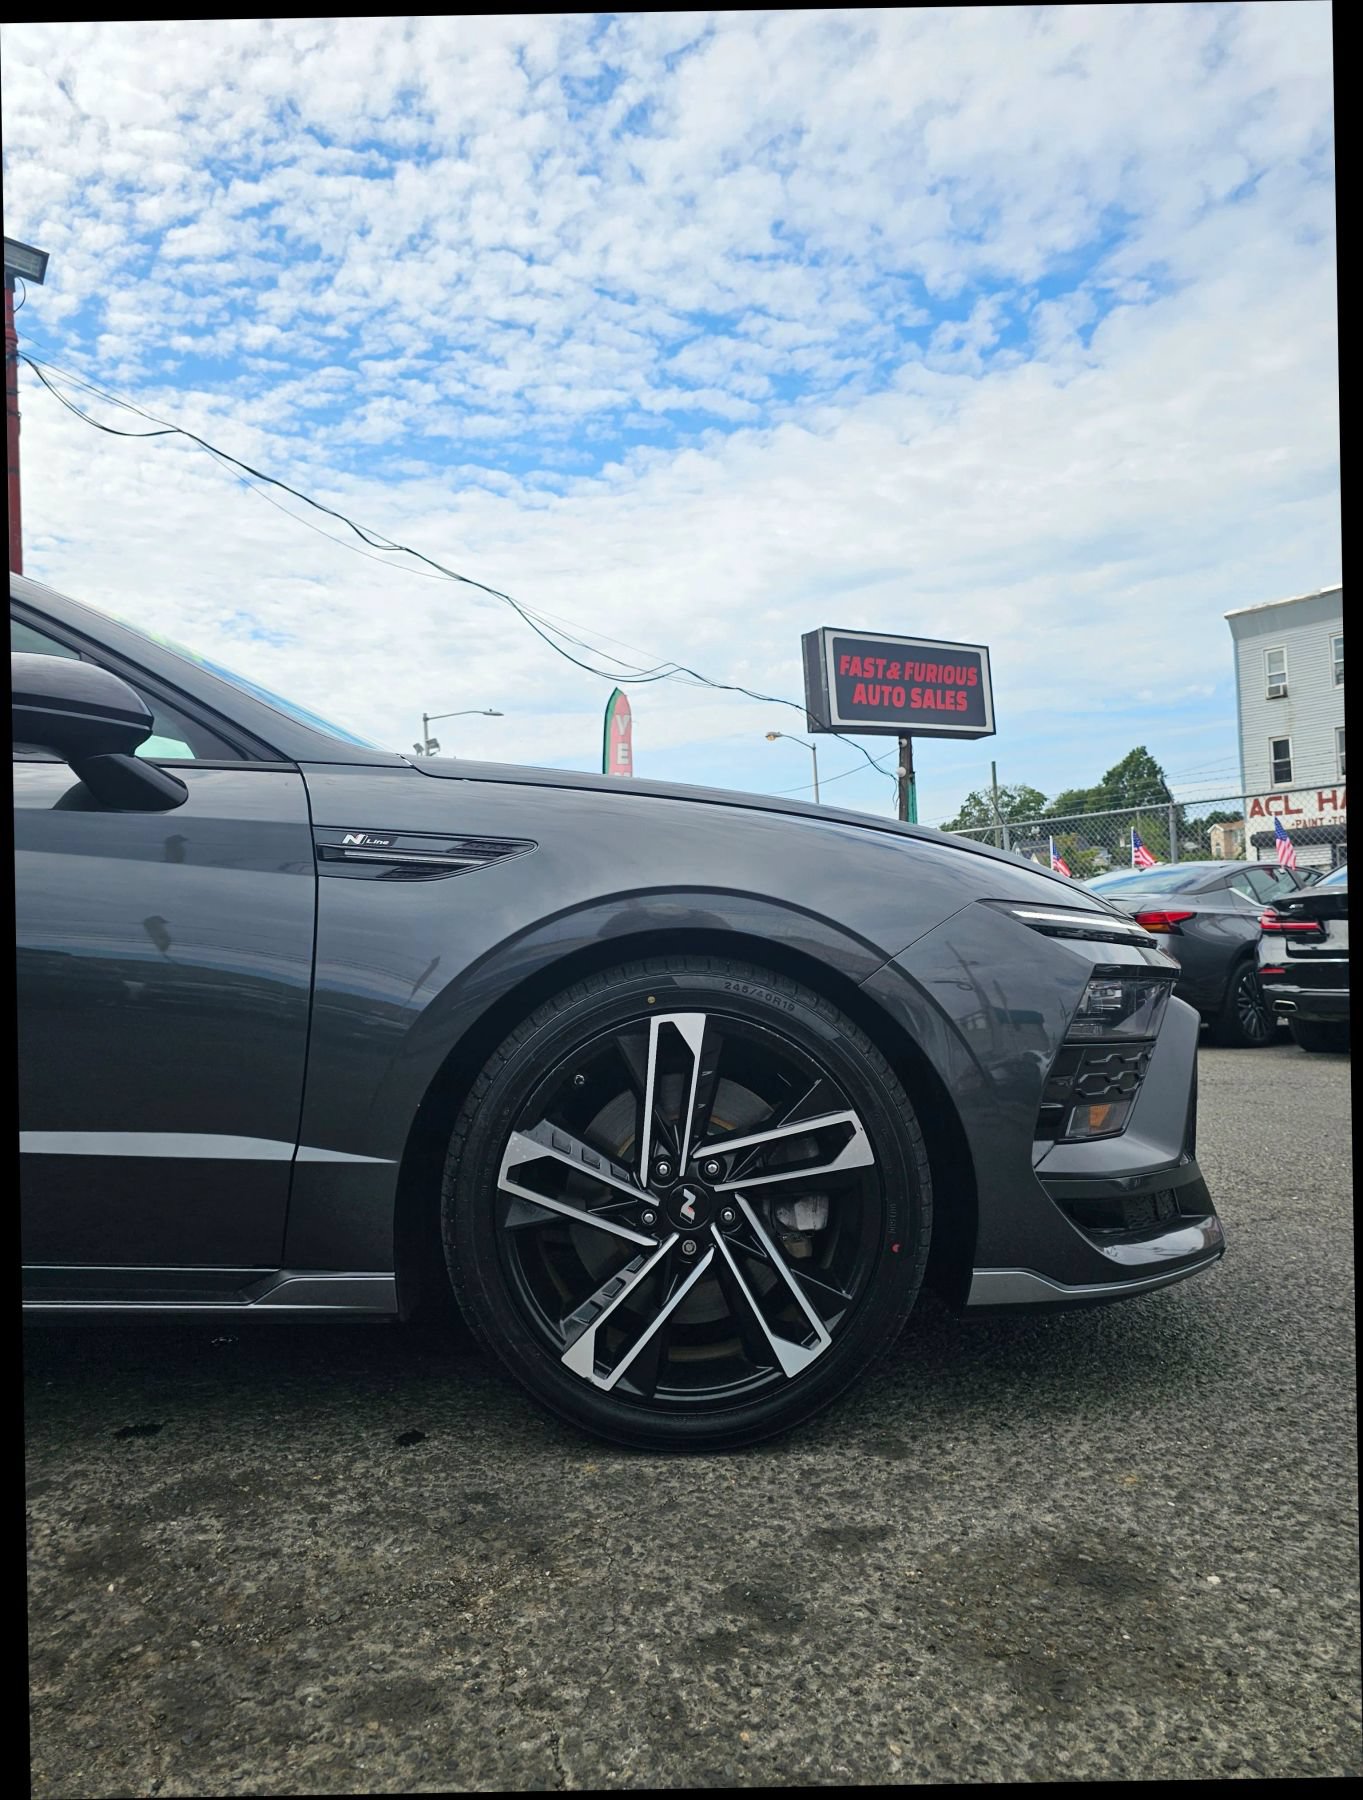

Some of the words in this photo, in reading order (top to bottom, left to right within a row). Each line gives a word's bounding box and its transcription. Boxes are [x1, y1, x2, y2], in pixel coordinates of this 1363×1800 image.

[839, 655, 886, 680] FAST
[886, 661, 900, 680] &
[904, 661, 977, 687] FURIOUS
[852, 683, 906, 708] AUTO
[910, 687, 968, 711] SALES
[614, 714, 631, 777] VE
[1249, 795, 1303, 818] ACL
[723, 981, 795, 1012] 245/40R19
